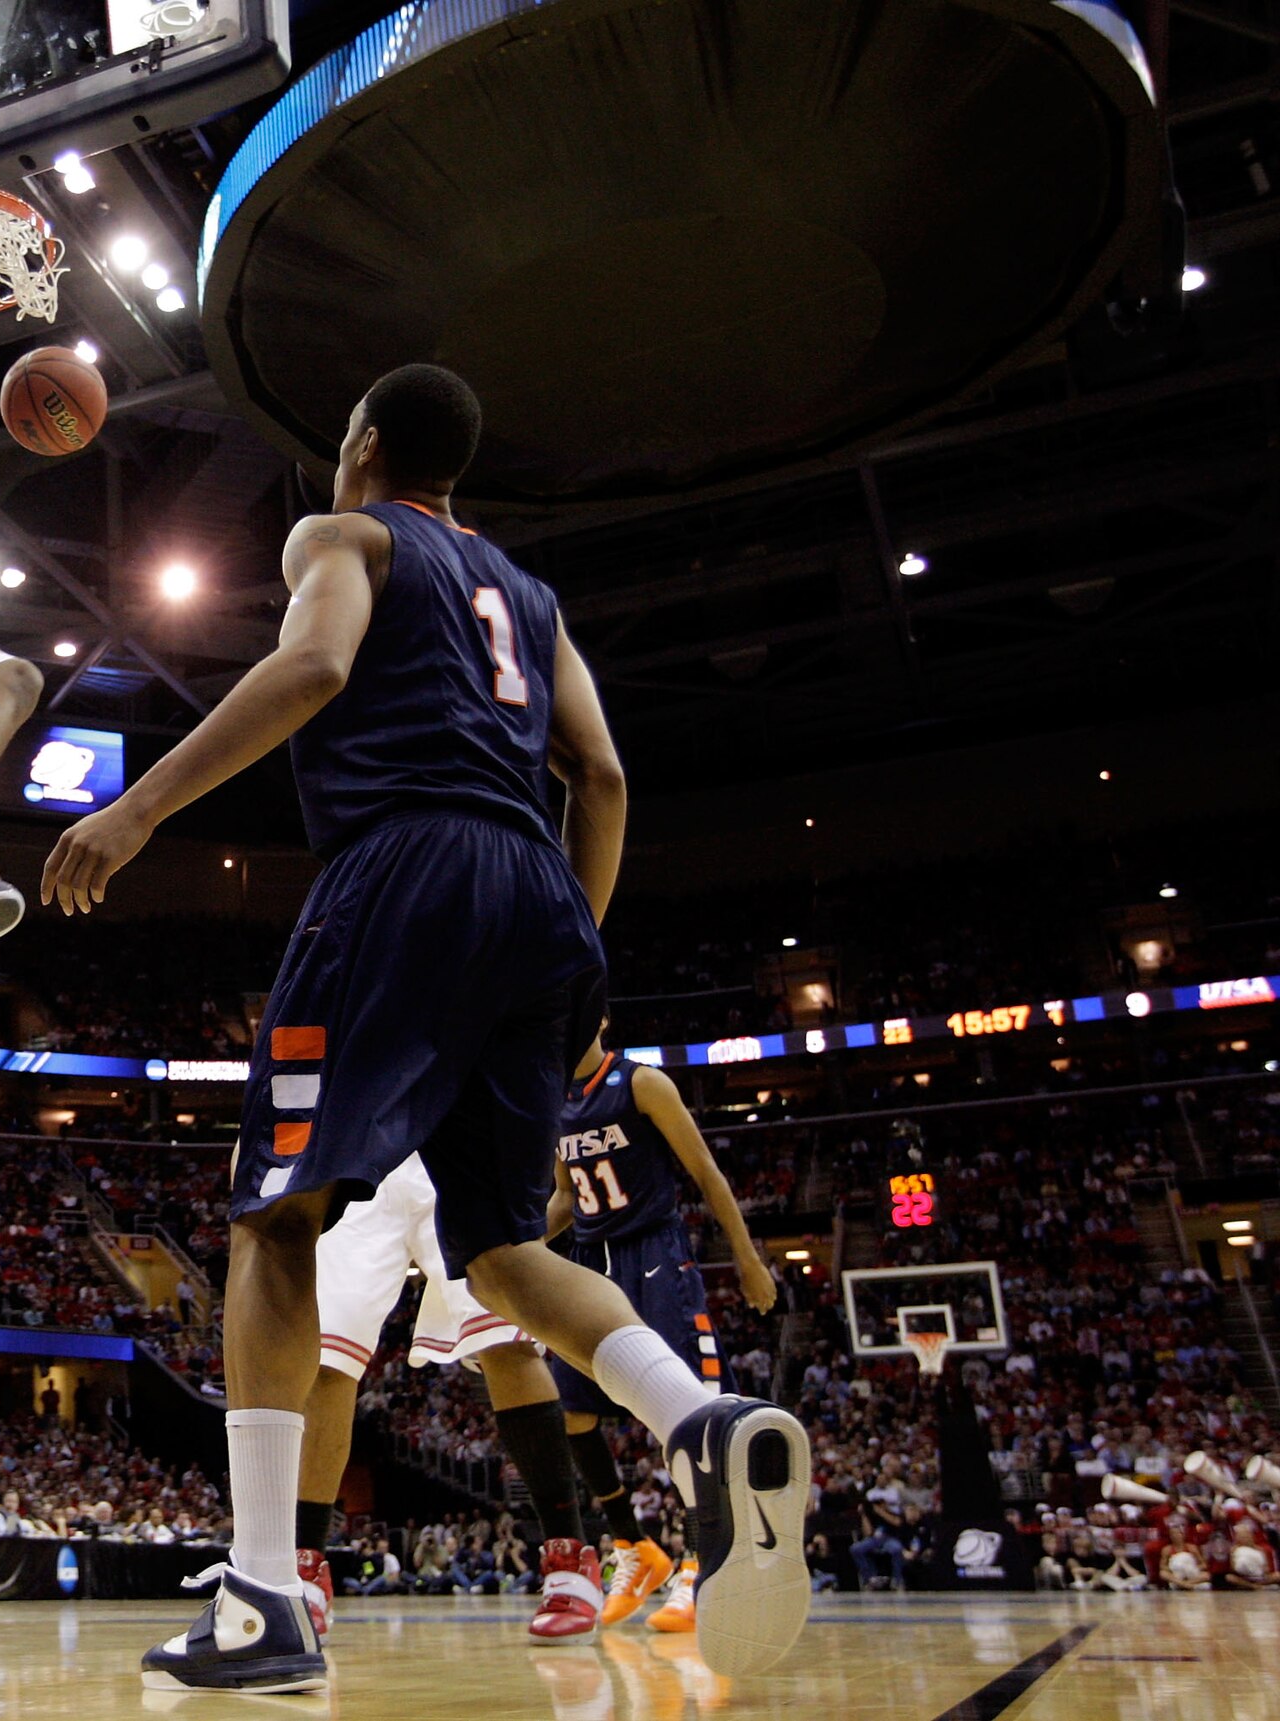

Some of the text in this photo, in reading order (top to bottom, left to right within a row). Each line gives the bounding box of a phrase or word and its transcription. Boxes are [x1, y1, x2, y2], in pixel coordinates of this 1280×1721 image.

[43, 390, 83, 445] Wilson
[471, 586, 528, 706] 1
[1199, 976, 1272, 1001] UTSA
[946, 1005, 1031, 1038] 15:57
[569, 1158, 629, 1216] 31
[891, 1192, 933, 1227] 22
